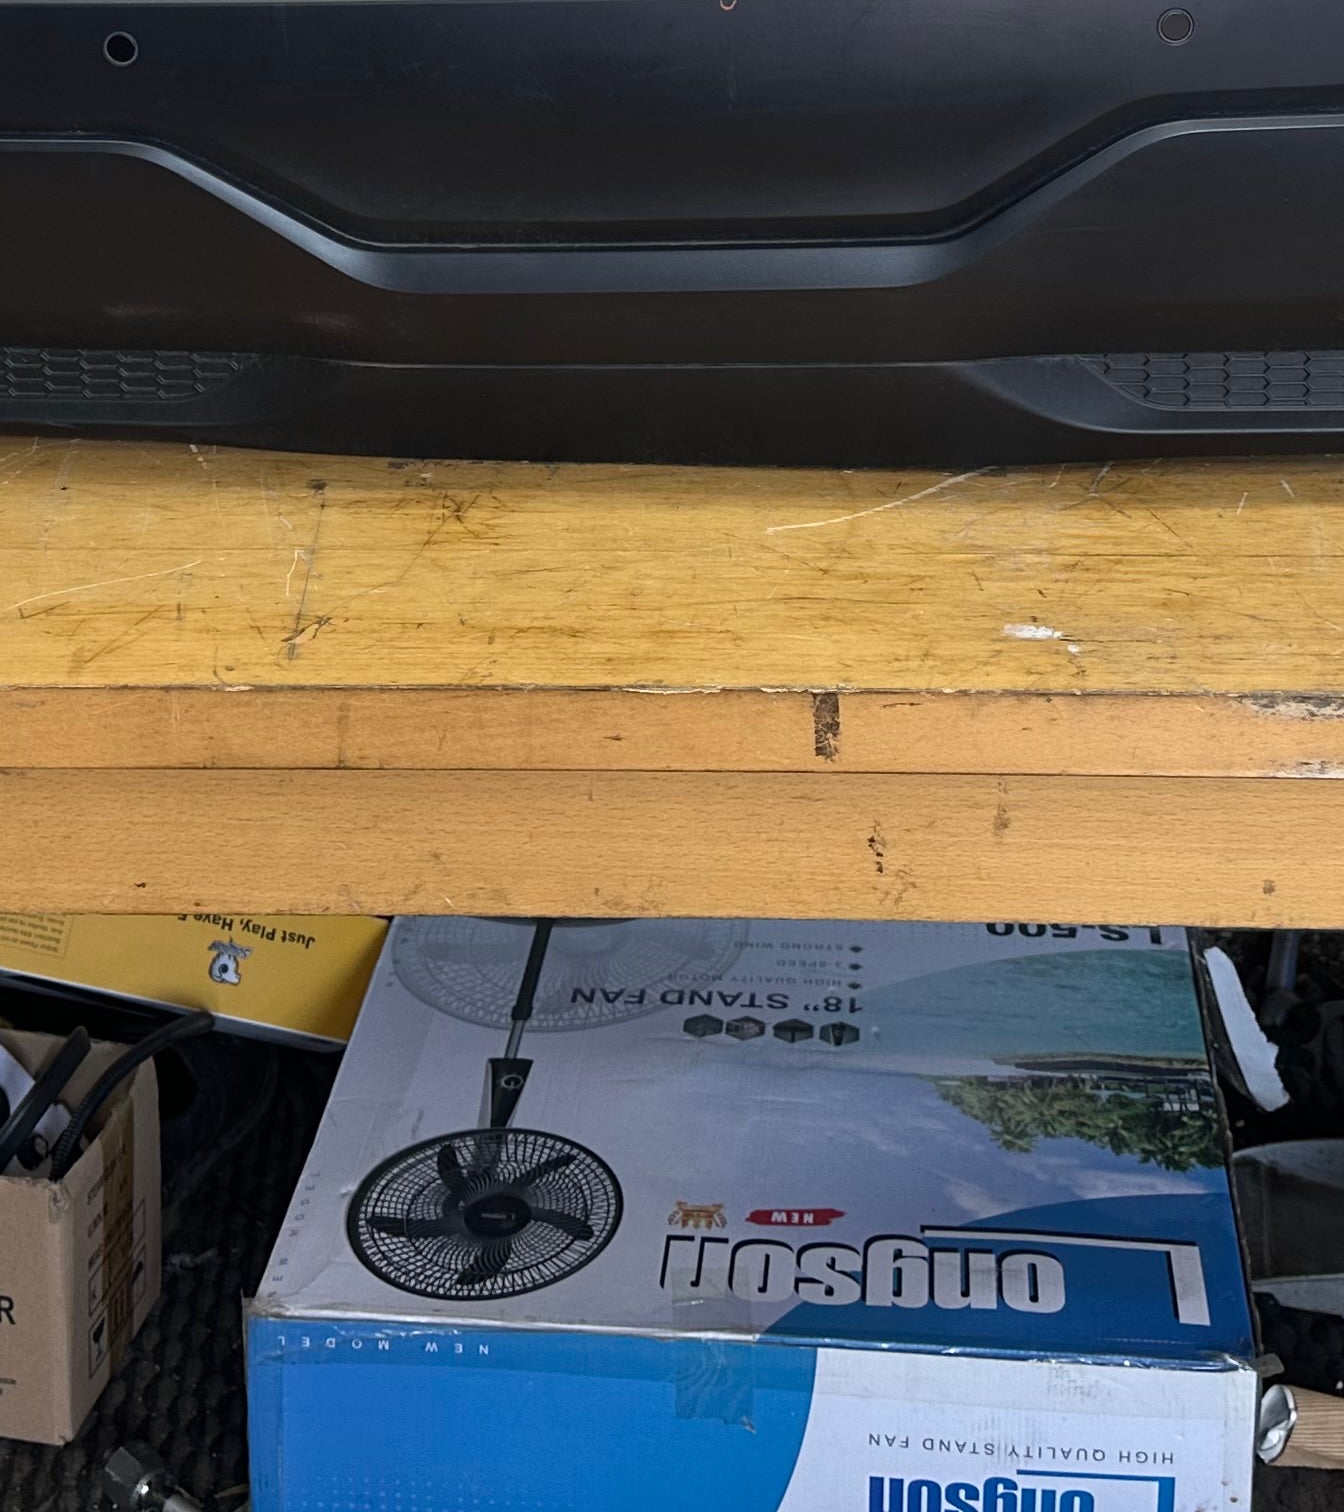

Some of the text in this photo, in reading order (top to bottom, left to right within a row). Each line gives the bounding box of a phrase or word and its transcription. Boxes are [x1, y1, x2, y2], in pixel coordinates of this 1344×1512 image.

[240, 918, 277, 942] Play,
[281, 930, 316, 949] Just
[570, 987, 647, 1005] FAN
[659, 989, 791, 1011] STAND
[769, 1209, 815, 1225] NEW
[277, 1336, 489, 1355] NEW MODEL
[868, 1433, 1174, 1465] HIGH QUALITY STAND FAN
